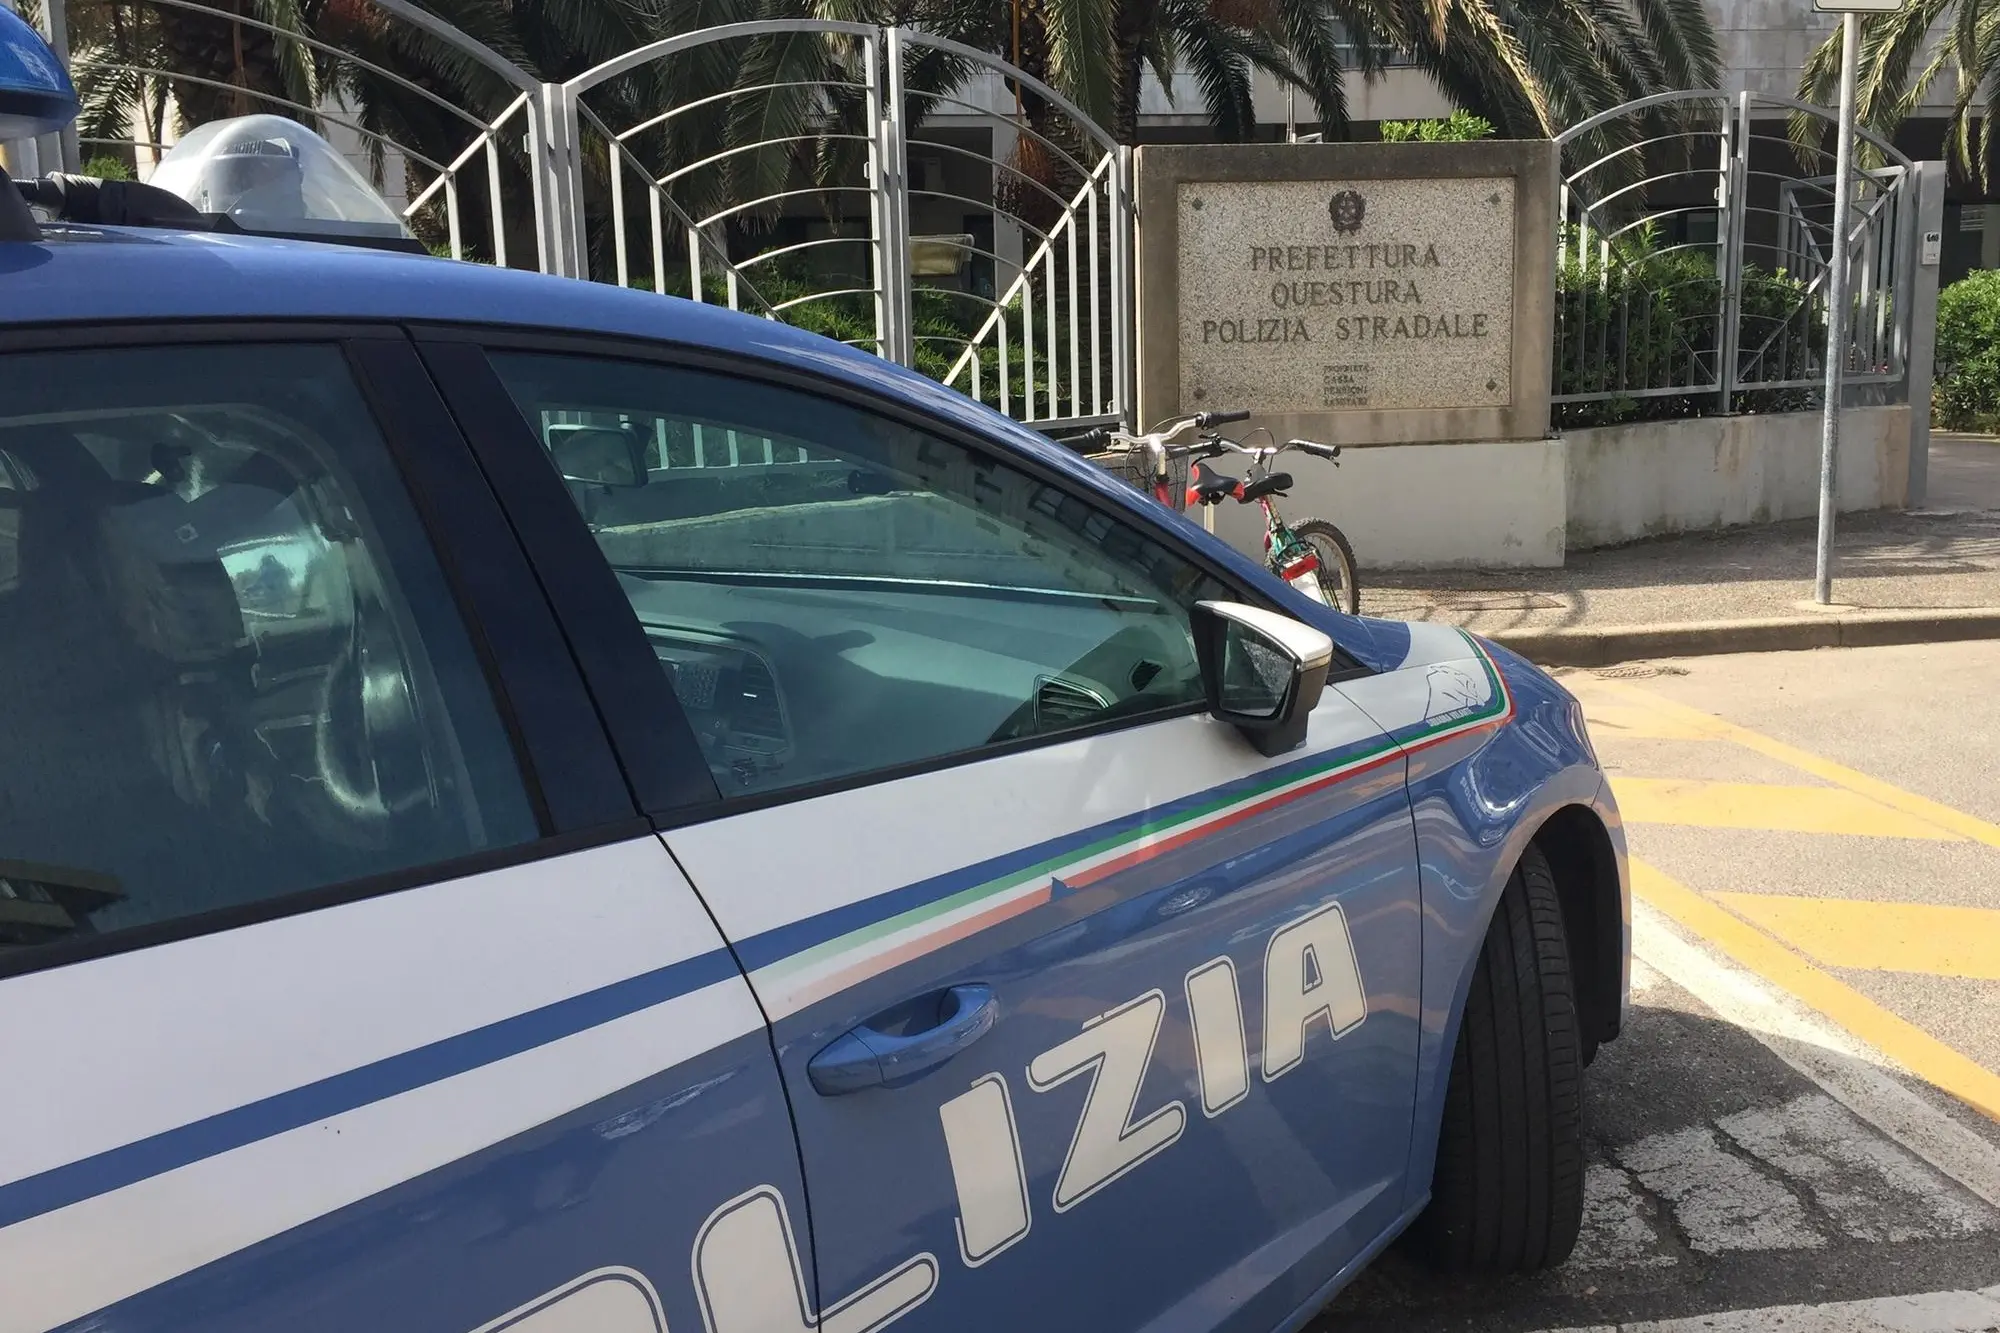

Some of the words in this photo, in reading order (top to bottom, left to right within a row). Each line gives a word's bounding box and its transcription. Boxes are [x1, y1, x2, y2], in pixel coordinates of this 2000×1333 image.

[1250, 244, 1441, 271] PREFETTURA
[1271, 280, 1422, 309] QUESTURA
[1202, 317, 1311, 344] POLIZIA
[1335, 314, 1489, 340] STRADALE
